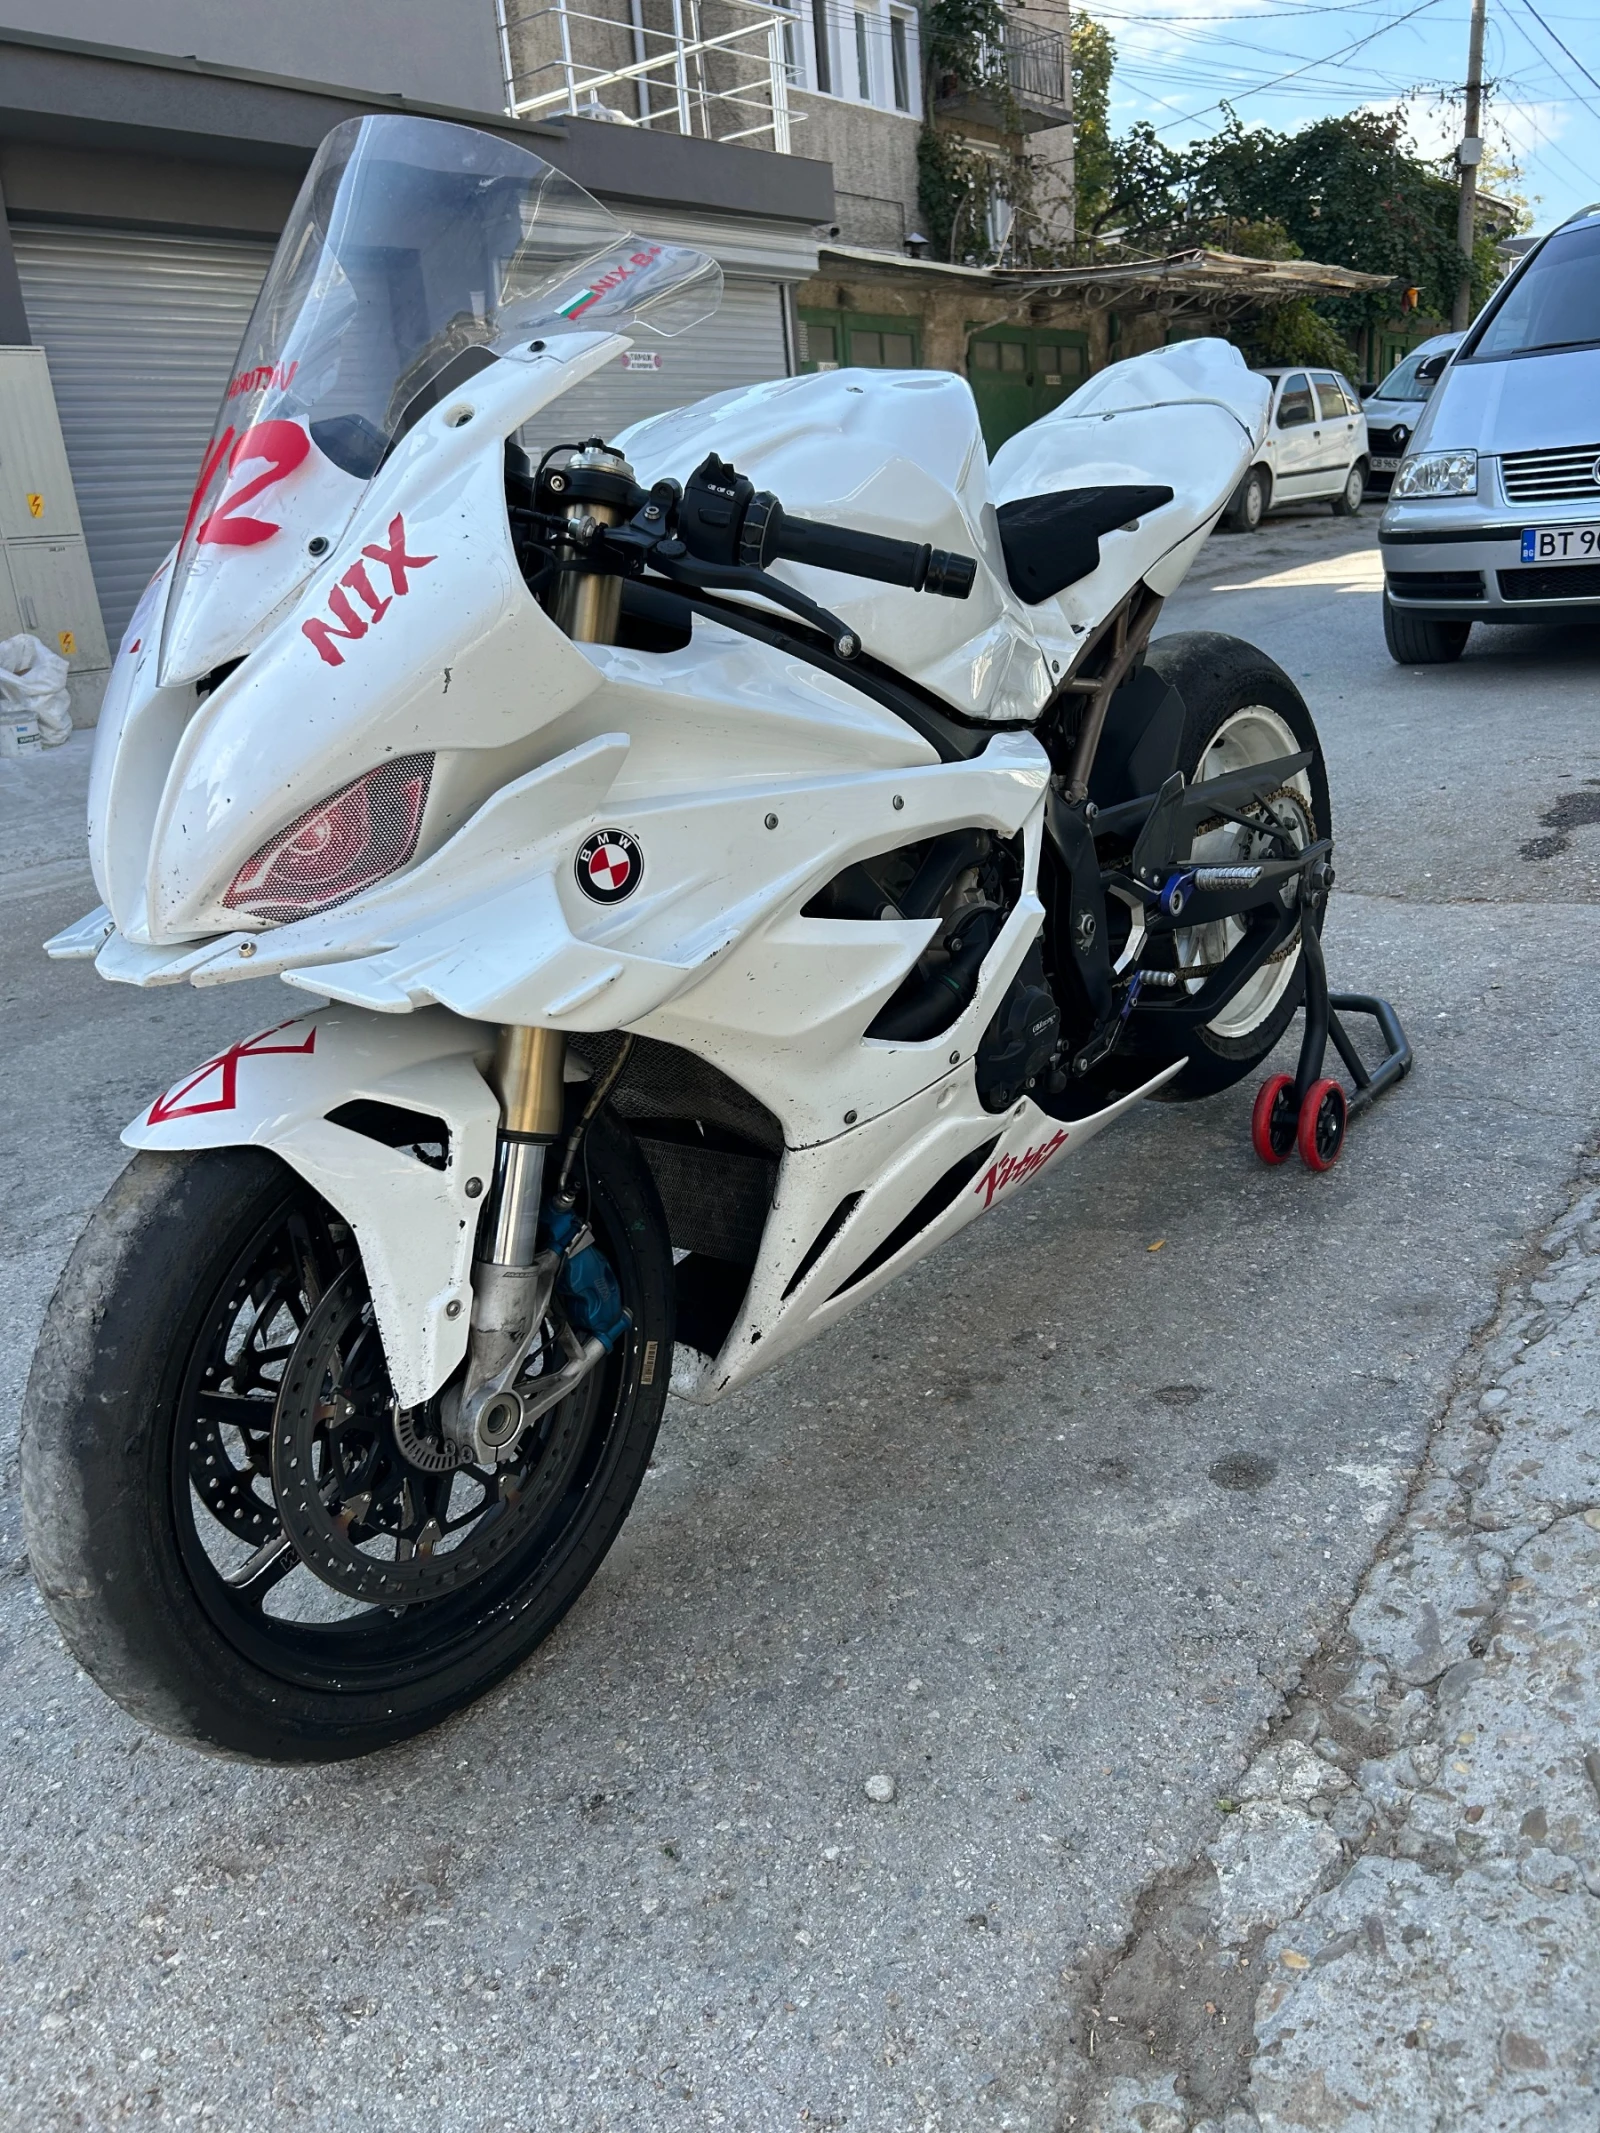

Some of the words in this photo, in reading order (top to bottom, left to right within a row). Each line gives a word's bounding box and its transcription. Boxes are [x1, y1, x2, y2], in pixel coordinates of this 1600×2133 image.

[590, 265, 635, 296] NIX
[1384, 458, 1401, 469] 965
[1523, 549, 1534, 557] BG
[1540, 531, 1574, 556] BT
[302, 512, 438, 667] NIX
[580, 832, 632, 862] BMW
